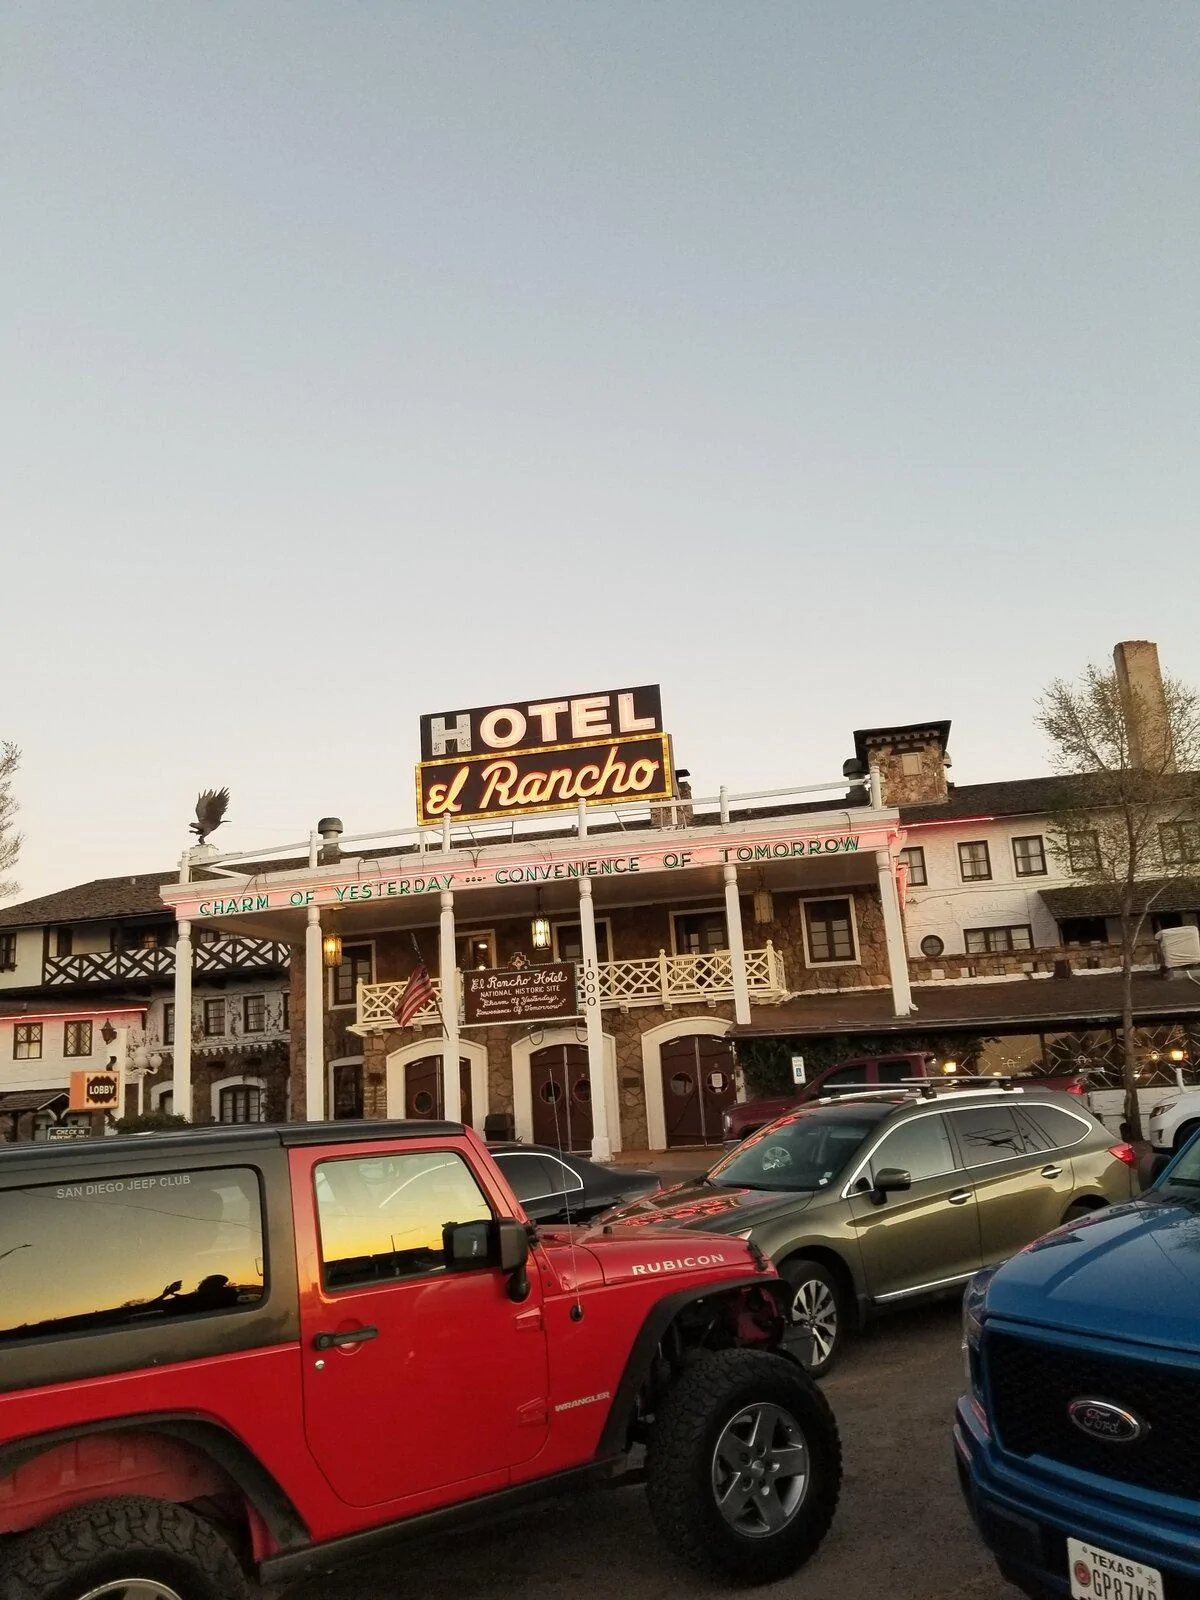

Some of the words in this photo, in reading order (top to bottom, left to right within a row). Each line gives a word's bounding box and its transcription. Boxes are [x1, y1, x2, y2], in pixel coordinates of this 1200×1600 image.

[430, 693, 656, 756] HOTEL
[479, 746, 659, 809] Rancho
[199, 894, 269, 916] CHARM
[289, 889, 316, 906] OF
[334, 874, 455, 902] YESTERDAY
[495, 857, 640, 885] CONVENIENCE
[662, 851, 693, 869] OF
[719, 835, 860, 863] TOMORROW
[470, 978, 484, 992] El
[486, 974, 532, 989] Rancho
[533, 970, 568, 985] Hotel
[480, 989, 512, 998] NATIONAL
[515, 986, 545, 995] HISTORIC
[546, 984, 560, 992] SITE
[89, 1085, 114, 1095] LOBBY
[56, 1186, 83, 1199] SAN
[85, 1182, 124, 1195] DIEGO
[126, 1178, 157, 1191] JEEP
[159, 1175, 191, 1187] CLUB
[631, 1253, 725, 1276] RUBICON
[554, 1391, 610, 1412] WRANGLER
[1083, 1408, 1120, 1434] Ford
[1090, 1551, 1135, 1578] TEXAS
